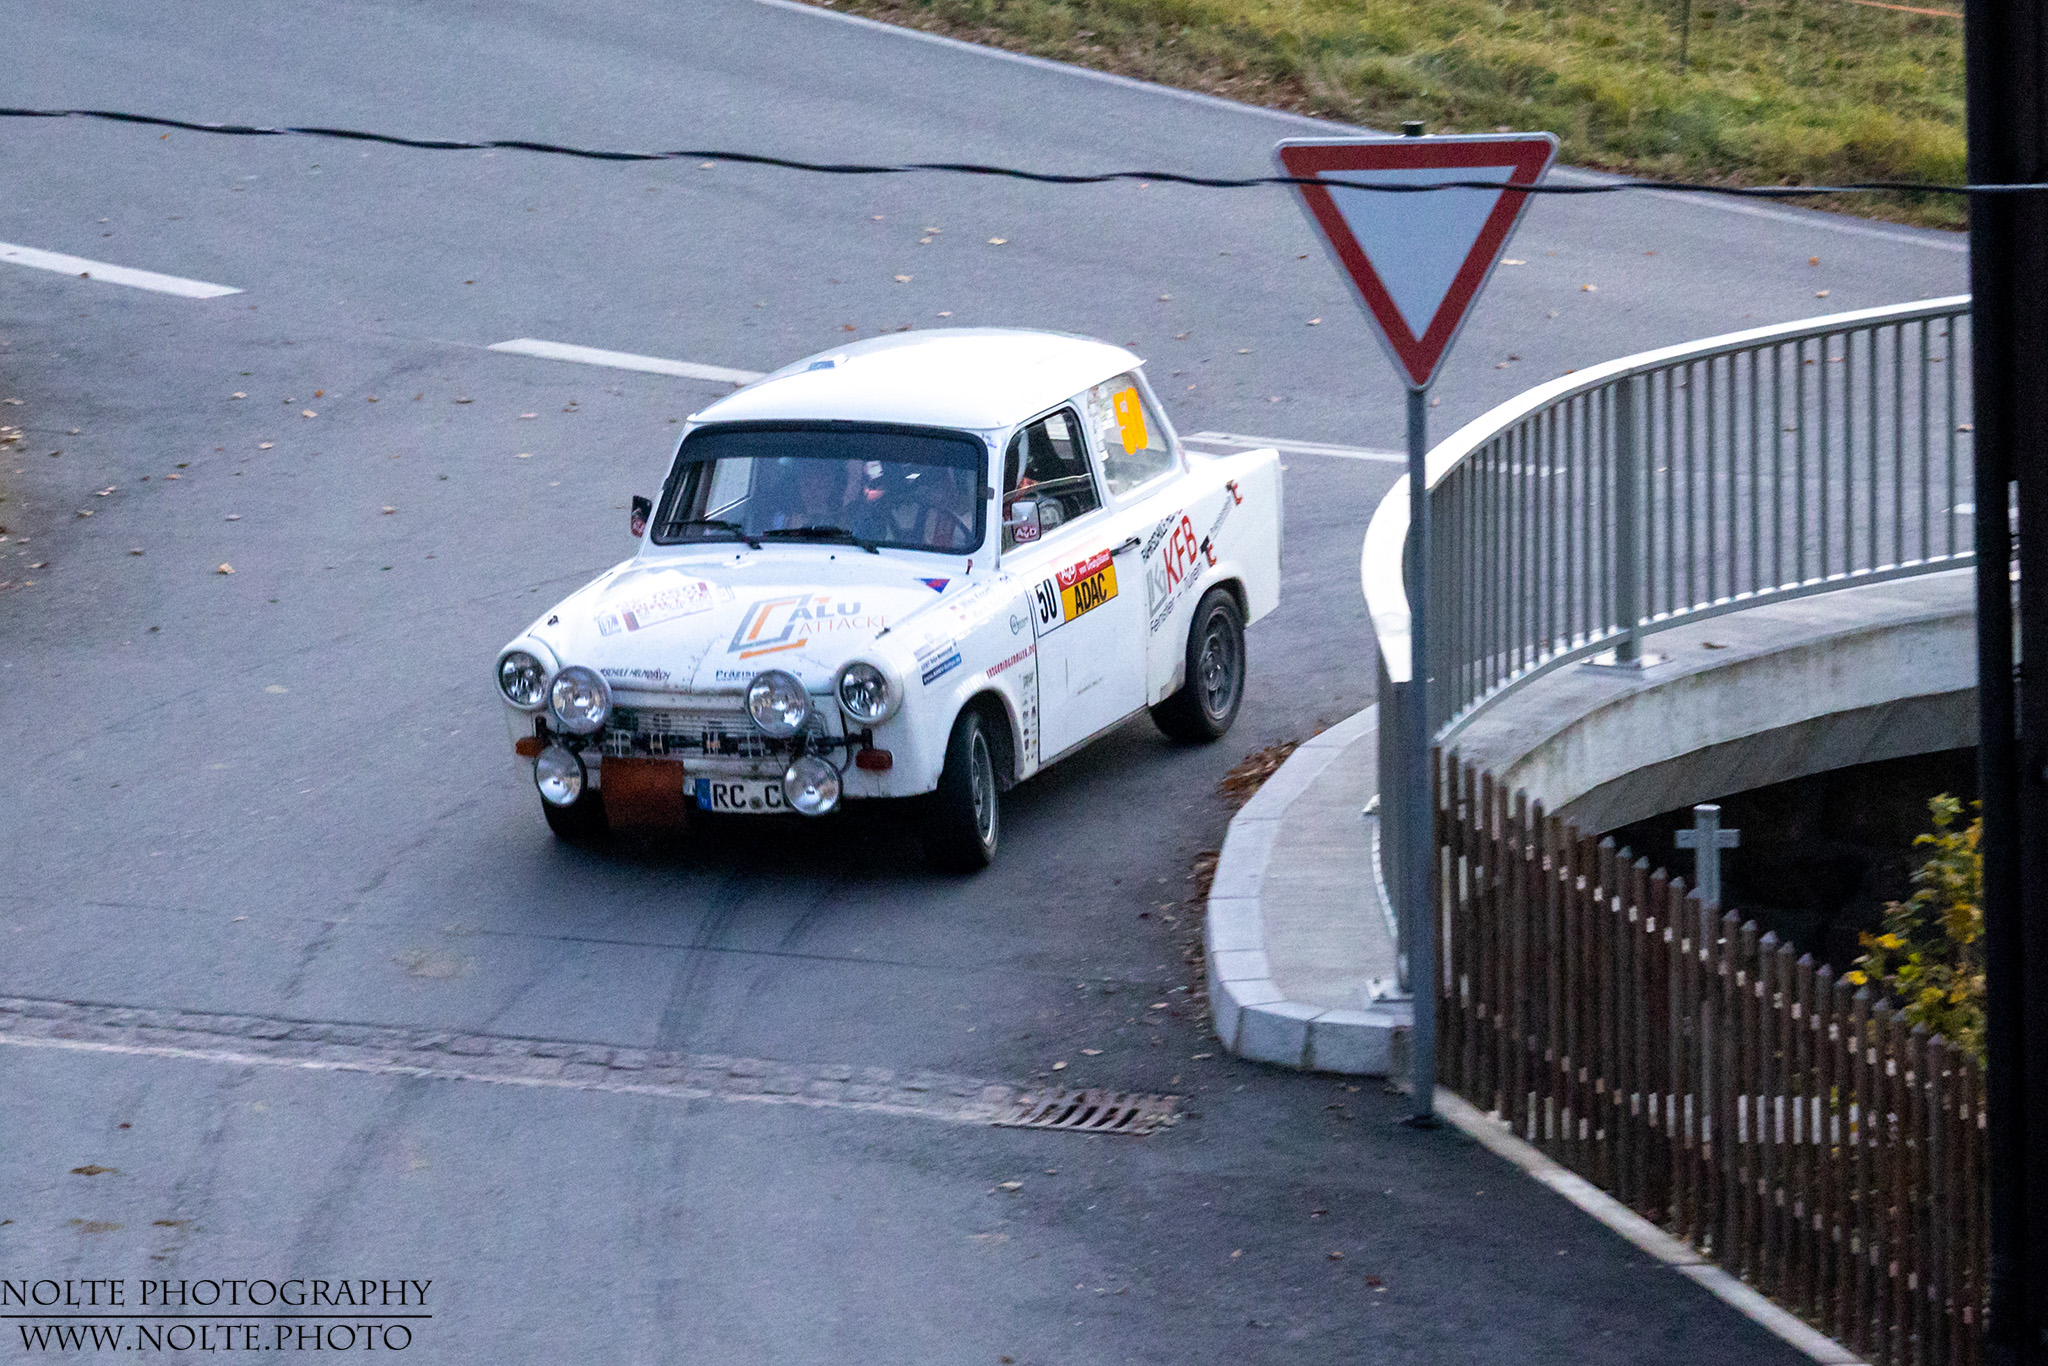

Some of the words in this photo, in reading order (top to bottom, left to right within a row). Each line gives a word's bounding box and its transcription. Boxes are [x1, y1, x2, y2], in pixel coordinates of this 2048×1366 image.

[1112, 387, 1148, 455] 50
[1163, 515, 1198, 594] KFB
[788, 601, 861, 623] ALU
[1034, 578, 1058, 624] 50
[1074, 572, 1107, 615] ADAC
[713, 784, 746, 808] RC
[764, 784, 791, 808] C
